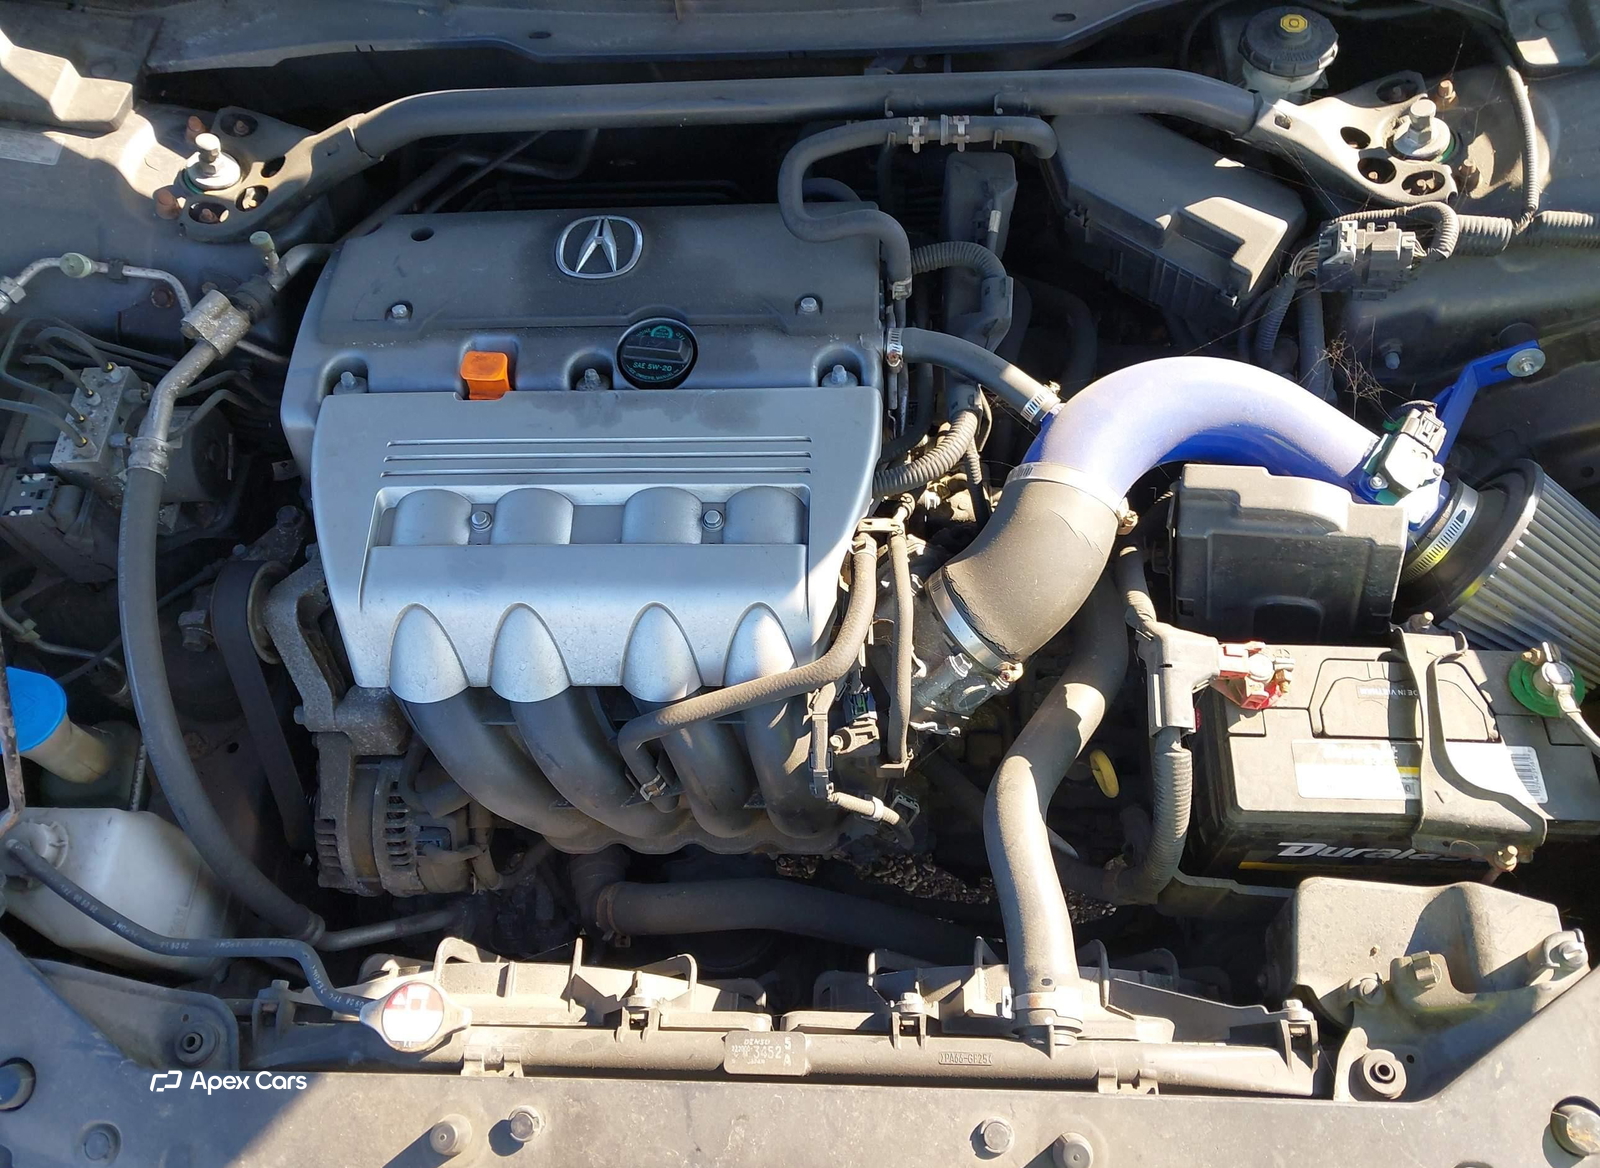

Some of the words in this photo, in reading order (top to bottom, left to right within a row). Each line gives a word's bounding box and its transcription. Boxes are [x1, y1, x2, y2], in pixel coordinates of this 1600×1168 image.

[633, 362, 645, 370] SAE
[646, 363, 673, 372] 5W-20
[1278, 842, 1488, 862] Durala
[743, 1038, 771, 1046] DENSO
[784, 1053, 792, 1067] A
